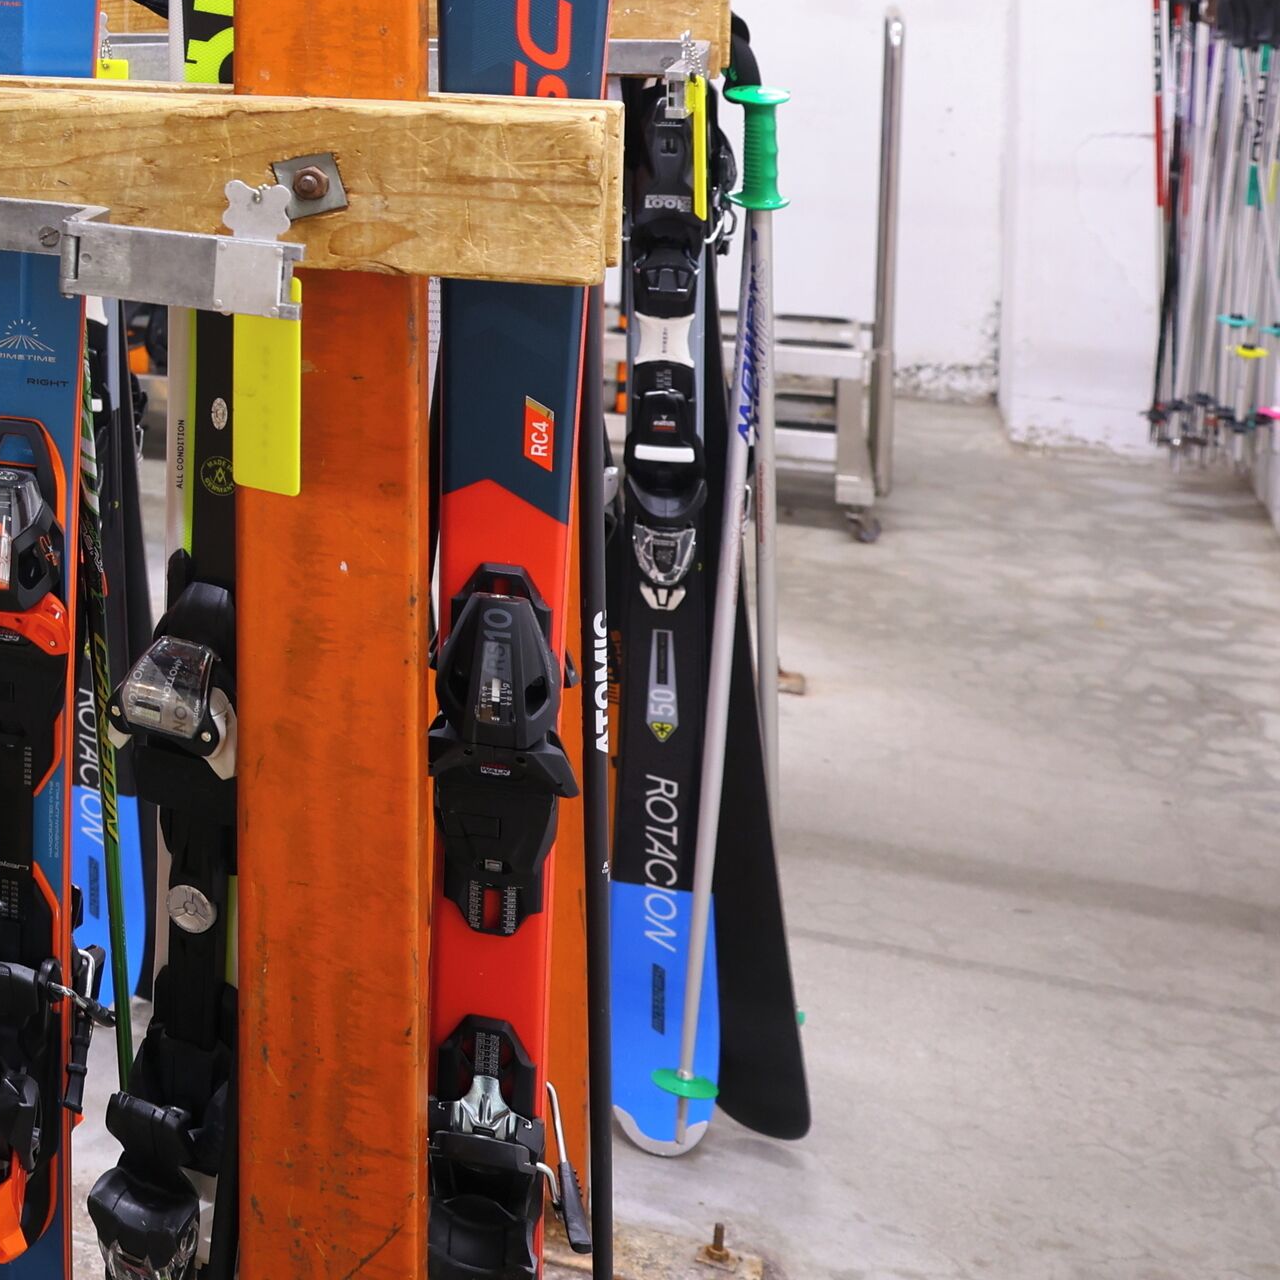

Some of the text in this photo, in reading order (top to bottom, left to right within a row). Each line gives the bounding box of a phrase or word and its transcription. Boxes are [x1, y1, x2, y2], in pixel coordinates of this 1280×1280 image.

[26, 376, 69, 388] RIGHT
[176, 419, 186, 489] ALL CONDITION
[530, 421, 549, 457] RC4
[483, 606, 513, 640] 10
[649, 688, 675, 718] 50
[644, 773, 679, 955] ROTACION
